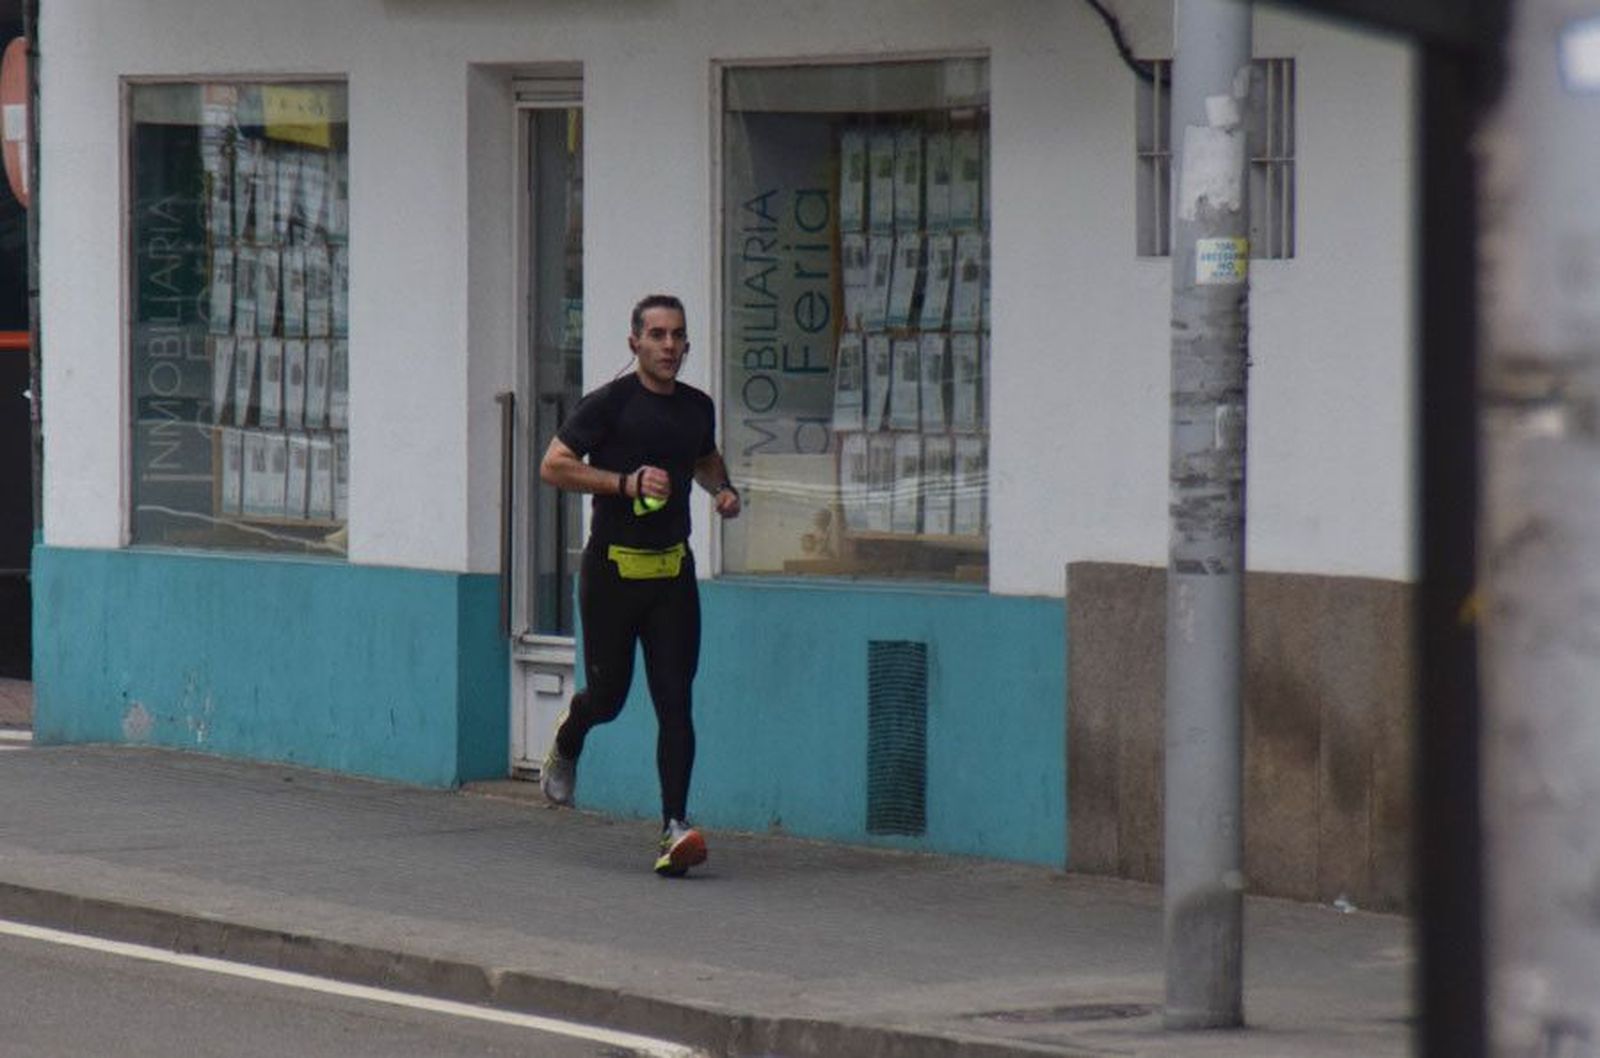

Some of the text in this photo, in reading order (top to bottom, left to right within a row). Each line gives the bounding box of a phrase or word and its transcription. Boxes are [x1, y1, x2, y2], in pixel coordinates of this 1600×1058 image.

[142, 194, 192, 482] INMOBILIARIA
[742, 188, 779, 490] MOBILIARIA
[783, 188, 829, 374] Feria
